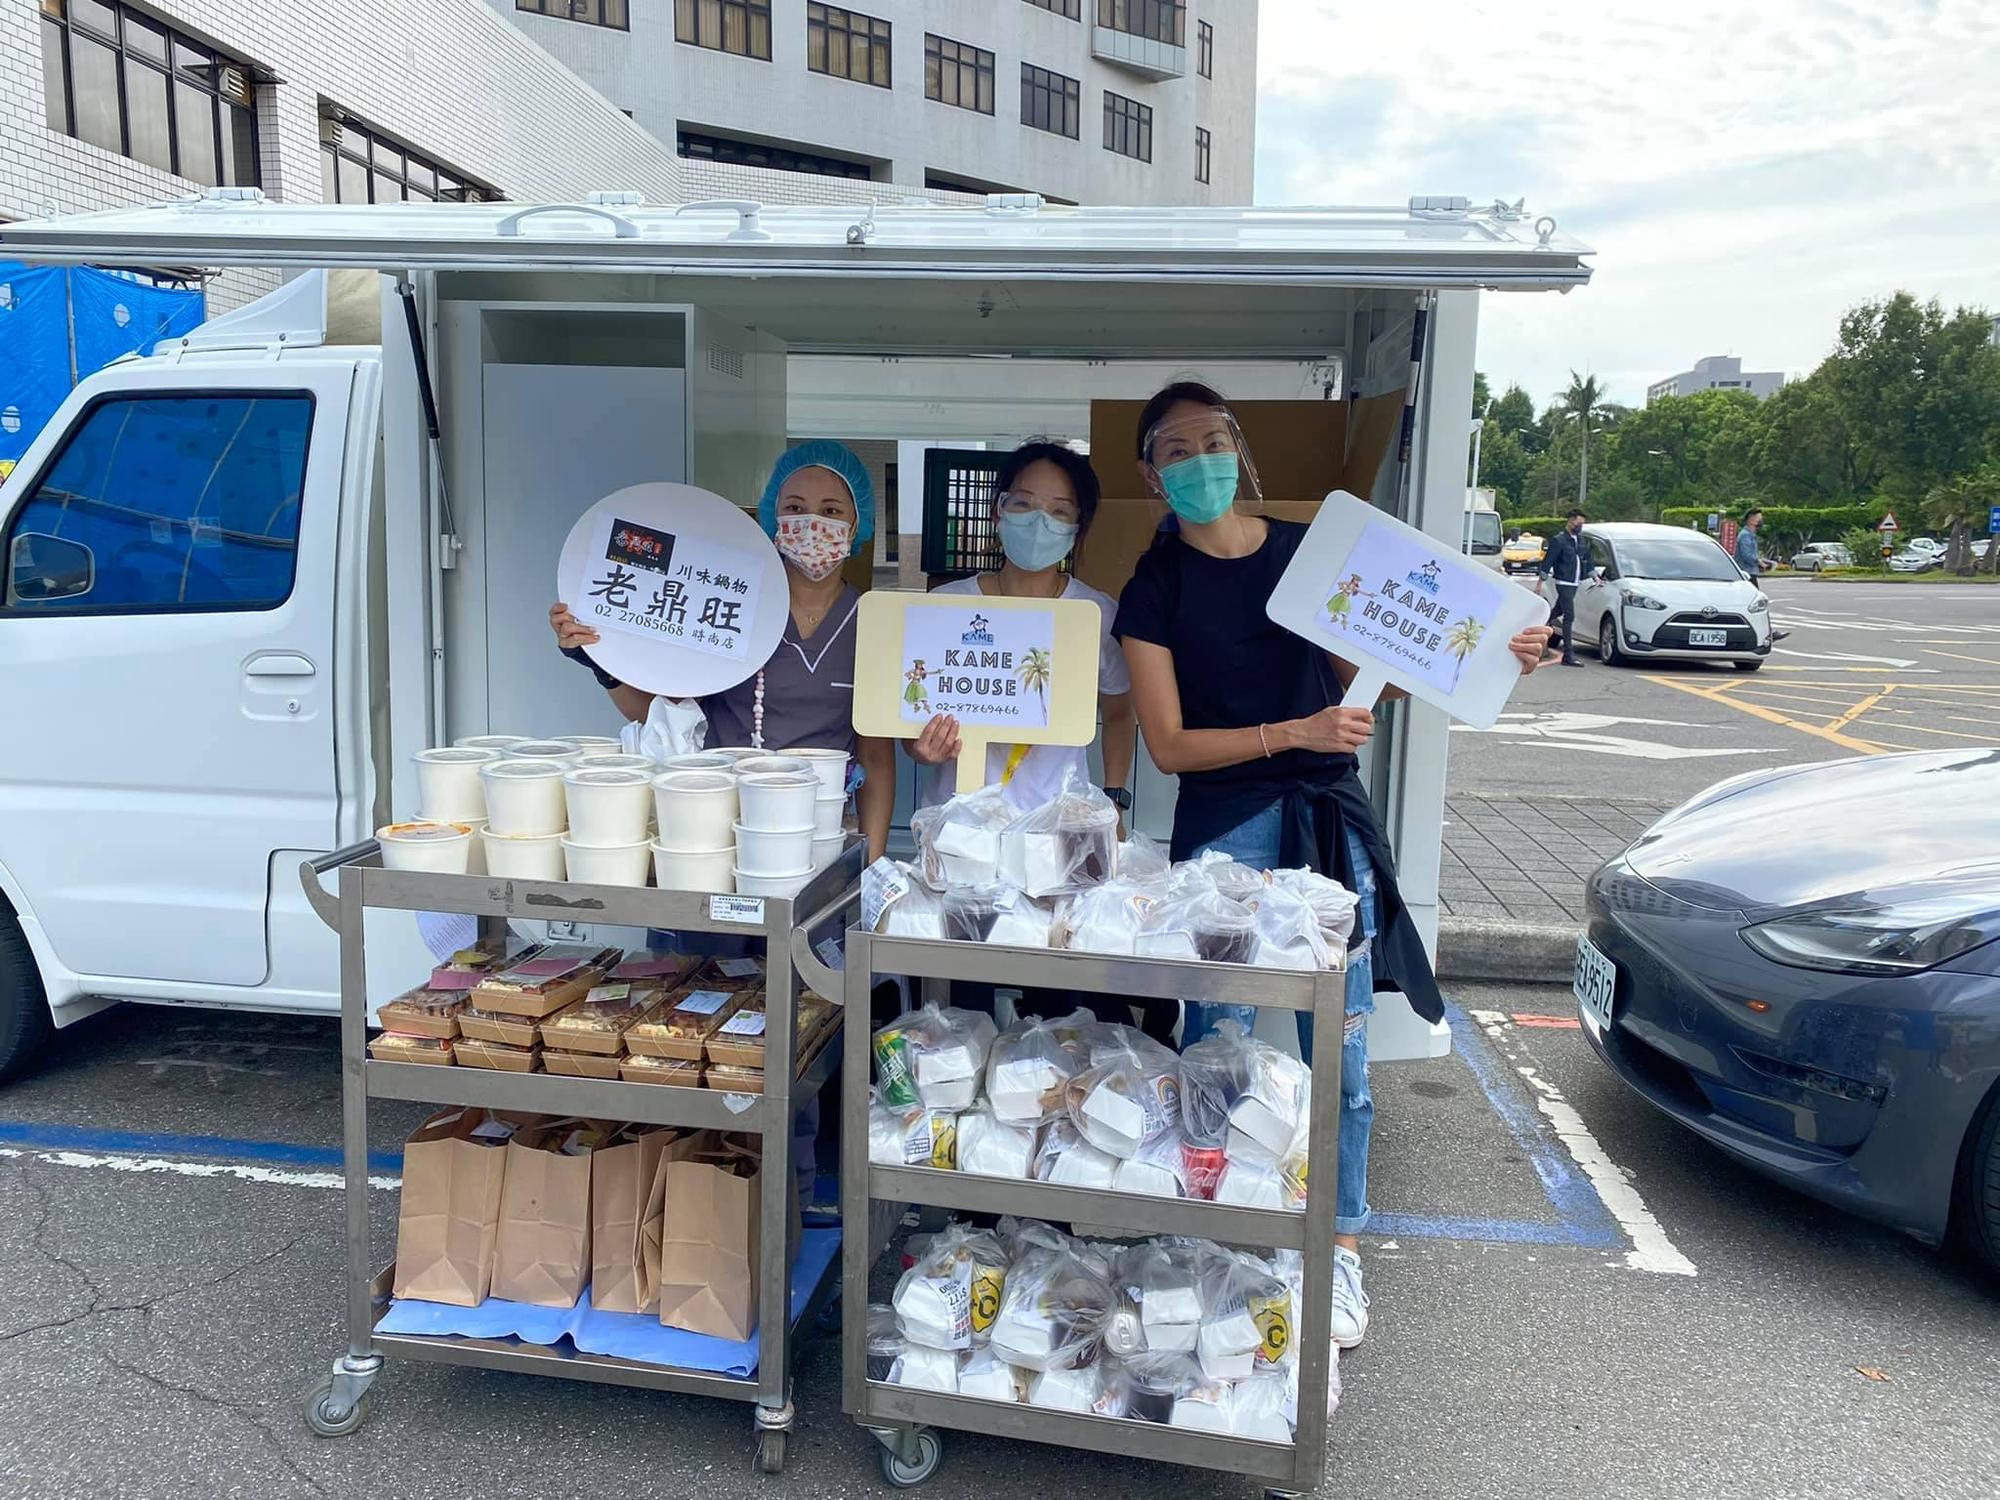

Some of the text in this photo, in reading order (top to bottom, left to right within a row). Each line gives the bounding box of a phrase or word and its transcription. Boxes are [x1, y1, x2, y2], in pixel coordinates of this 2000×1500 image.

[677, 564, 748, 595] 川味鍋物
[588, 564, 742, 634] 老鼎旺
[1381, 579, 1449, 626] KAME
[594, 604, 684, 637] 02 27085668
[1362, 600, 1442, 653] HOUSE
[691, 629, 734, 649] 時尚店
[961, 632, 994, 643] KAME
[1353, 623, 1432, 671] 02-87869466
[945, 650, 1013, 669] KAME
[938, 676, 1016, 696] HOUSE
[936, 703, 1019, 715] 02-87869466
